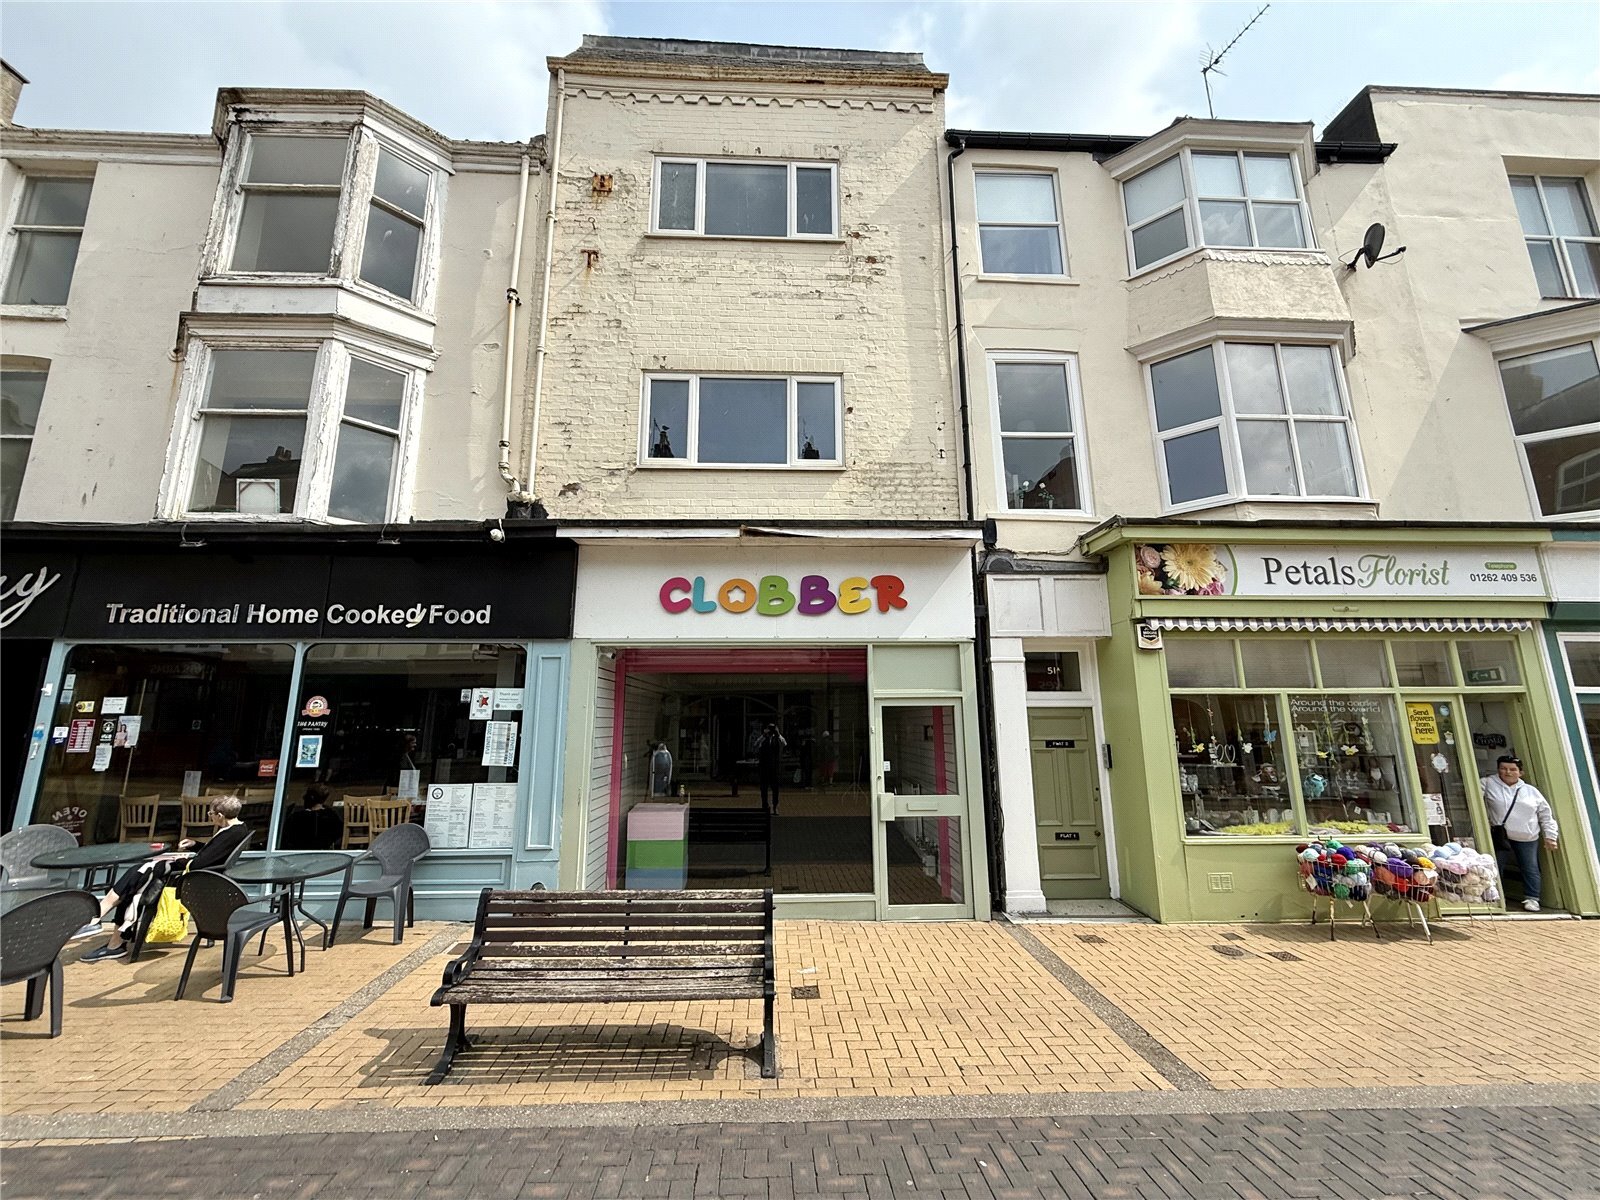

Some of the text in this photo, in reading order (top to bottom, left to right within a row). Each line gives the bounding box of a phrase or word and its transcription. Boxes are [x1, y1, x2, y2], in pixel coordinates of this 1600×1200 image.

[1261, 554, 1449, 588] Petals Florist
[1470, 573, 1537, 582] 01262 409 536
[659, 575, 908, 616] CLOBBER
[106, 603, 491, 628] Traditional Home Cooked Food
[1415, 726, 1435, 735] here!
